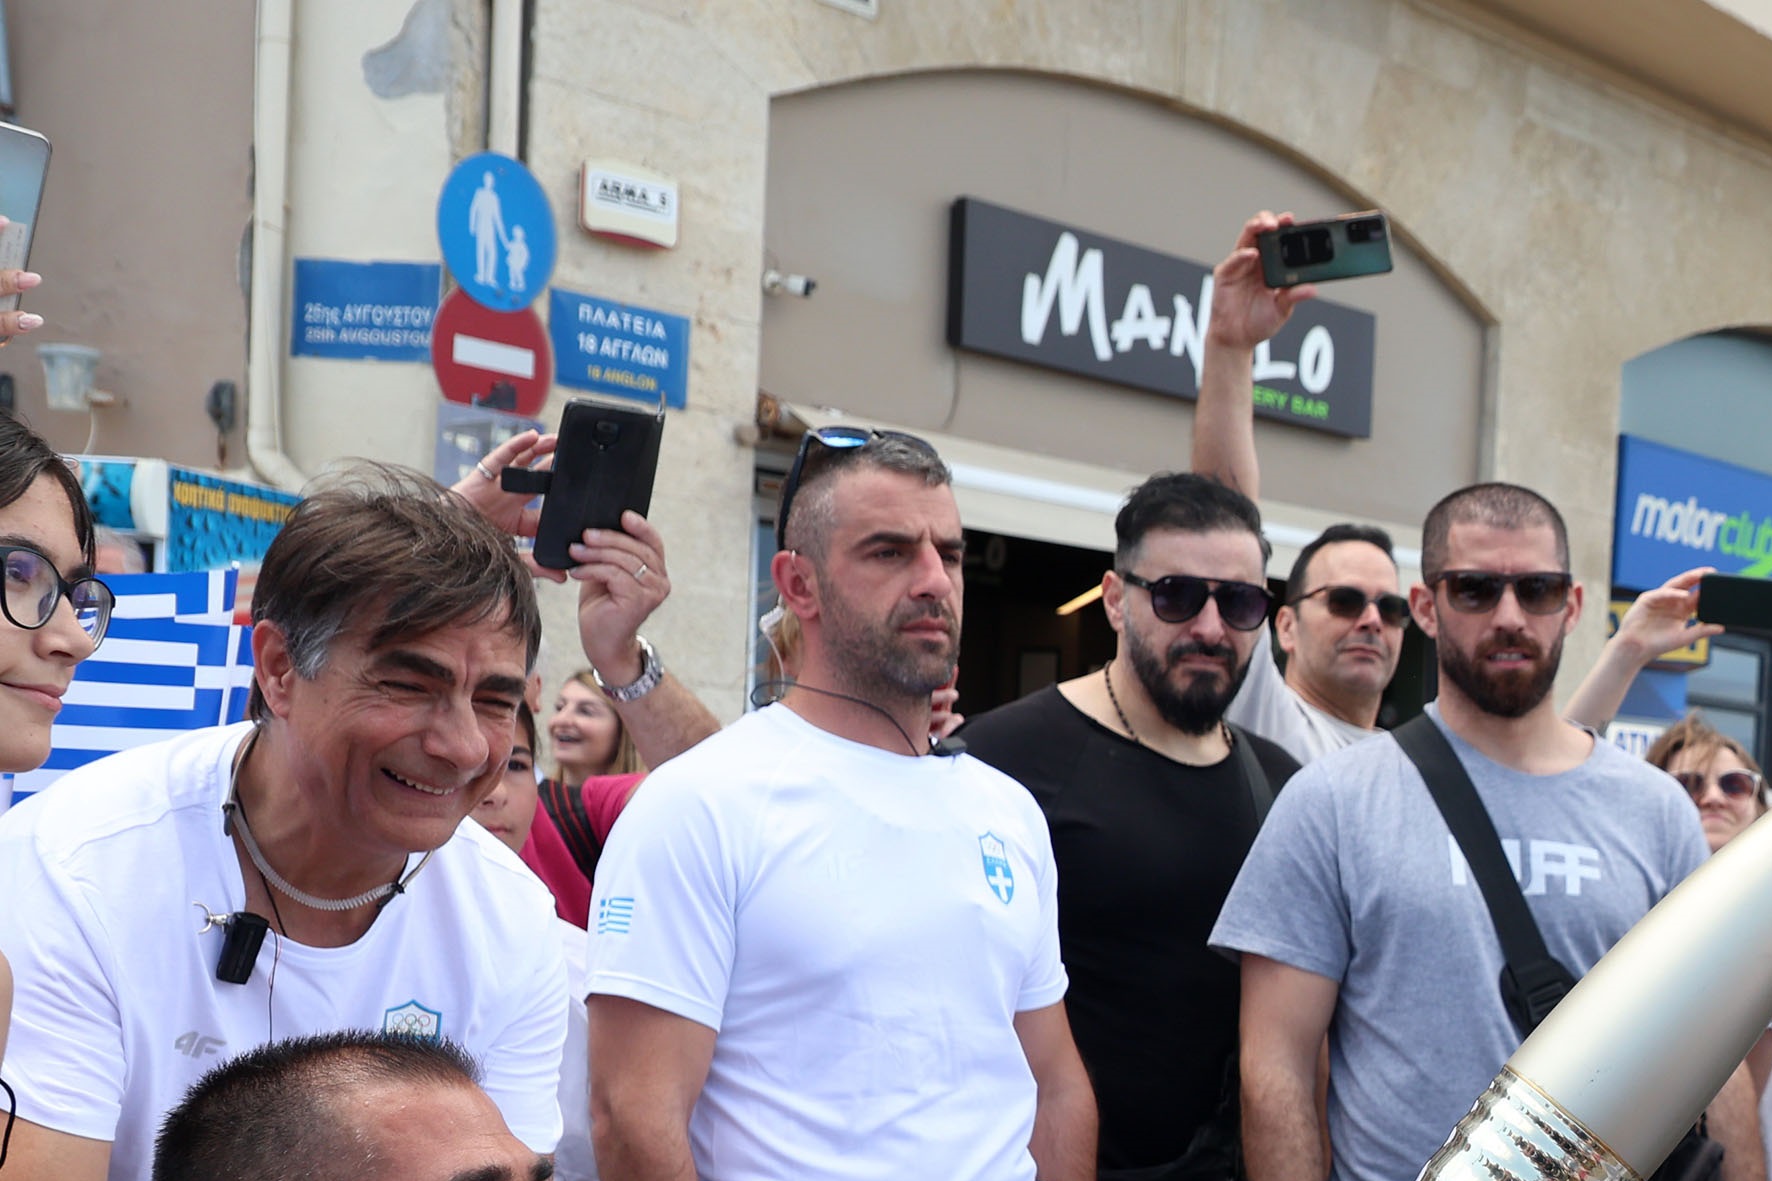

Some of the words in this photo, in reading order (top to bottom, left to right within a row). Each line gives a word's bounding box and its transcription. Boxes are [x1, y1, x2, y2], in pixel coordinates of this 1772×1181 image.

[578, 302, 667, 341] ΠΛΑΤΕΙΑ
[1021, 231, 1334, 395] MANLO
[1290, 393, 1330, 420] BAR
